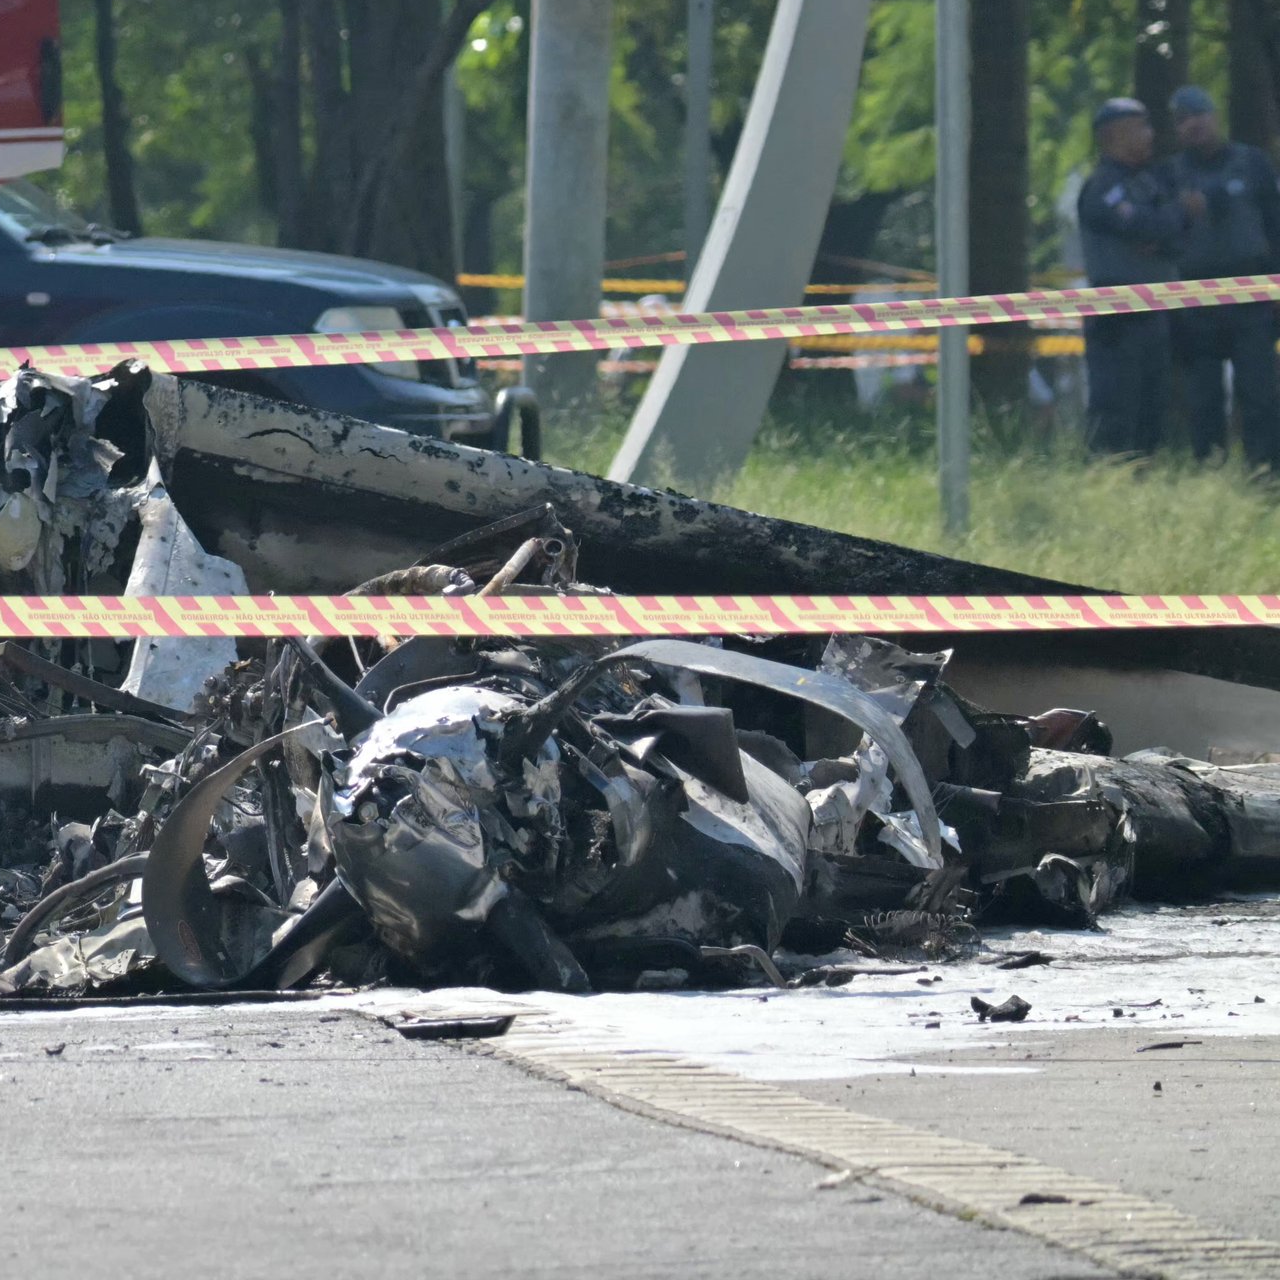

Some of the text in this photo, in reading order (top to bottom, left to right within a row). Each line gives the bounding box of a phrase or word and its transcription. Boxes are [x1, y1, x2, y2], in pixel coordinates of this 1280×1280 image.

[83, 612, 99, 621] NÃO
[100, 613, 152, 621] ULTRAPASSE
[181, 612, 307, 621] BOMBEIROS NÃO ULTRAPASSE
[334, 613, 383, 621] BOMBEIROS
[390, 612, 407, 620] NÃO
[488, 612, 614, 621] BOMBEIROS NÃO ULTRAPASSE
[699, 613, 716, 621] NÃO
[798, 613, 847, 621] BOMBEIROS
[854, 612, 871, 620] NÃO
[1009, 612, 1026, 620] NÃO
[1027, 612, 1080, 620] ULTRAPASSE
[1166, 611, 1183, 620] NÃO
